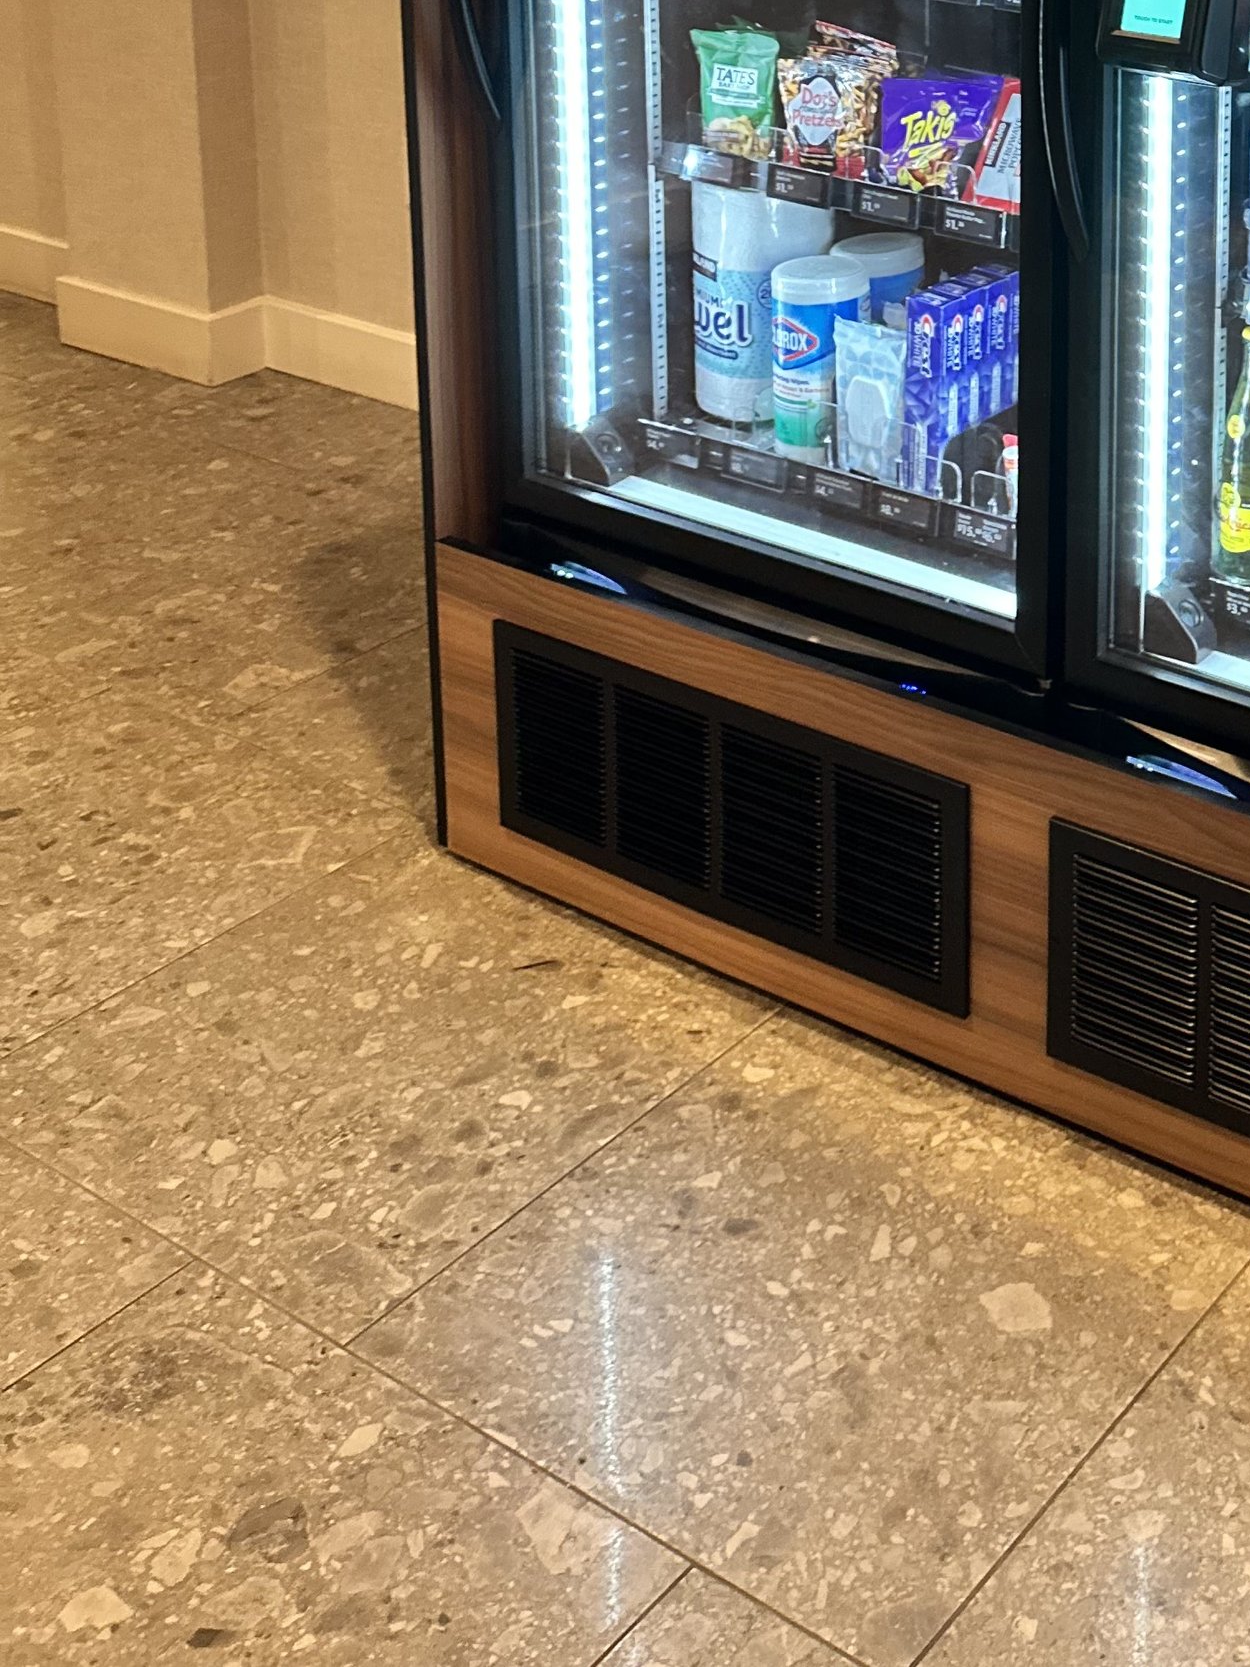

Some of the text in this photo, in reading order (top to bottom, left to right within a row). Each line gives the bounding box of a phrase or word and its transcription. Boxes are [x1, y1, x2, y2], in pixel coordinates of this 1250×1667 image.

[801, 87, 838, 110] Dot's
[792, 108, 843, 128] Pretzels
[900, 100, 957, 153] Takis
